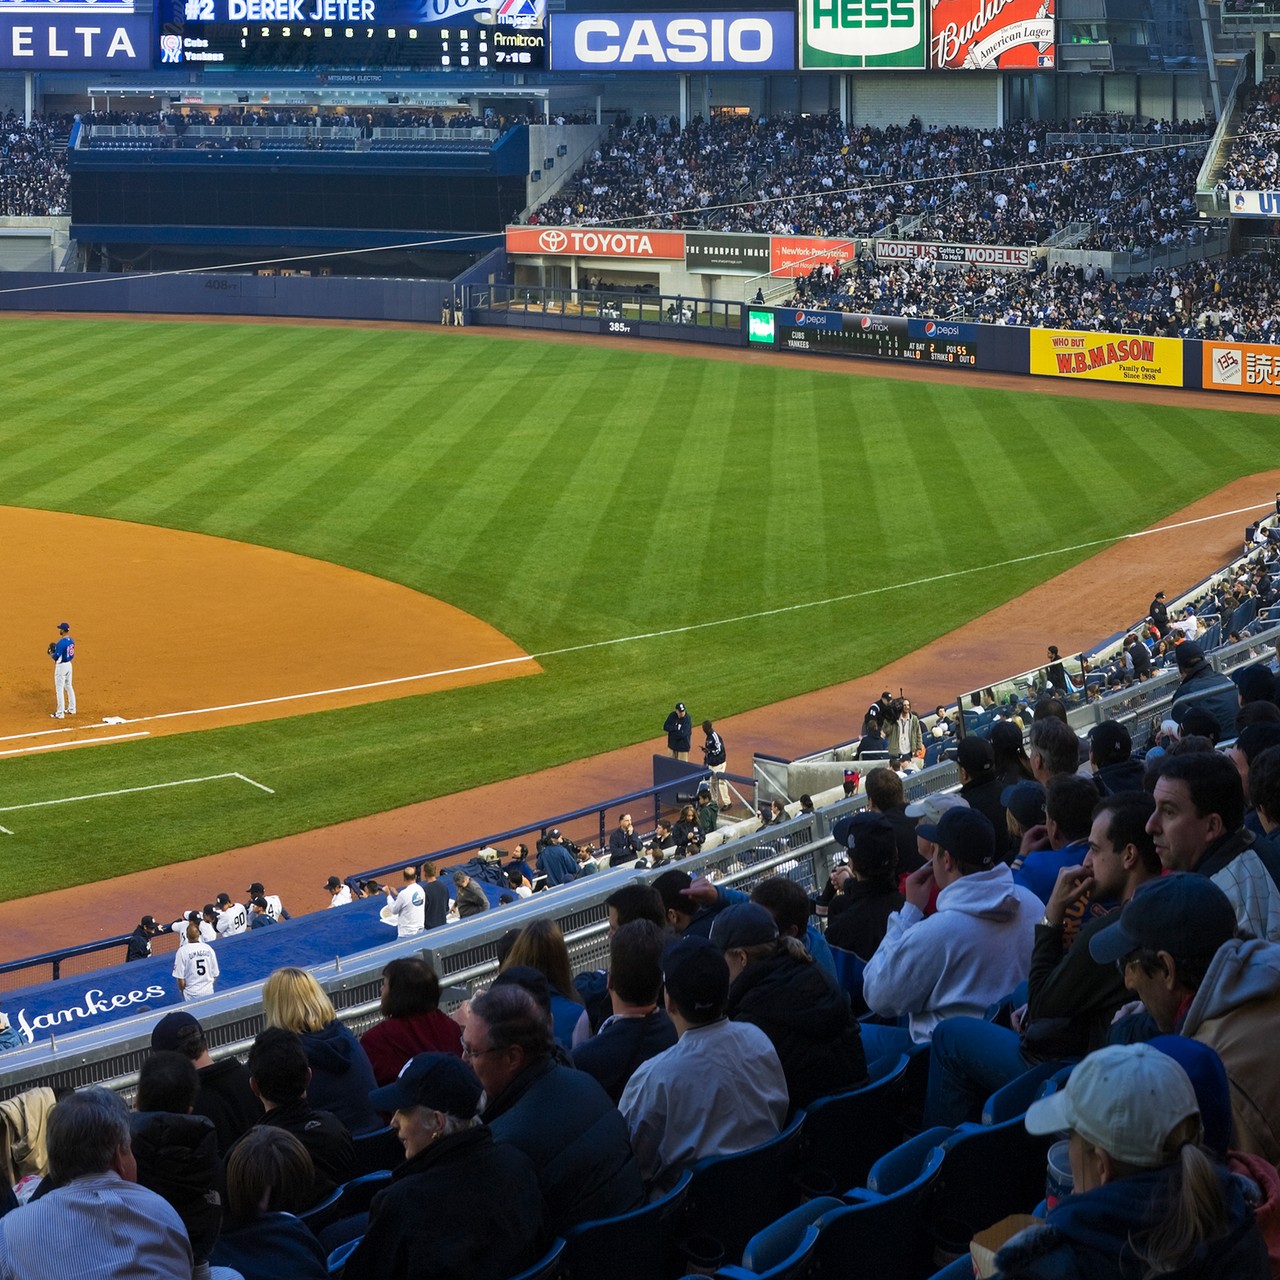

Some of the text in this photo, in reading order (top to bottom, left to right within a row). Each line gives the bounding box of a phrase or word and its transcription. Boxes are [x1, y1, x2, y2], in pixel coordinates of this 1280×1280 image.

[494, 32, 544, 47] Armitron
[574, 19, 774, 62] CASIO
[980, 27, 1051, 59] American Lager
[571, 233, 653, 254] TOYOTA
[687, 246, 769, 257] THE SHARPER IMAGE
[878, 243, 937, 258] MODELL'S
[965, 249, 1028, 264] MODELL'S
[806, 315, 826, 325] pepsi
[791, 331, 805, 339] CUBS
[937, 326, 959, 335] pepsi
[788, 340, 809, 348] YANKEES
[1052, 338, 1085, 347] WHO BUT
[903, 350, 915, 358] BALL
[930, 353, 948, 361] STRIKE
[1119, 365, 1161, 374] Family Owned
[234, 912, 245, 930] 90
[196, 959, 206, 976] 5
